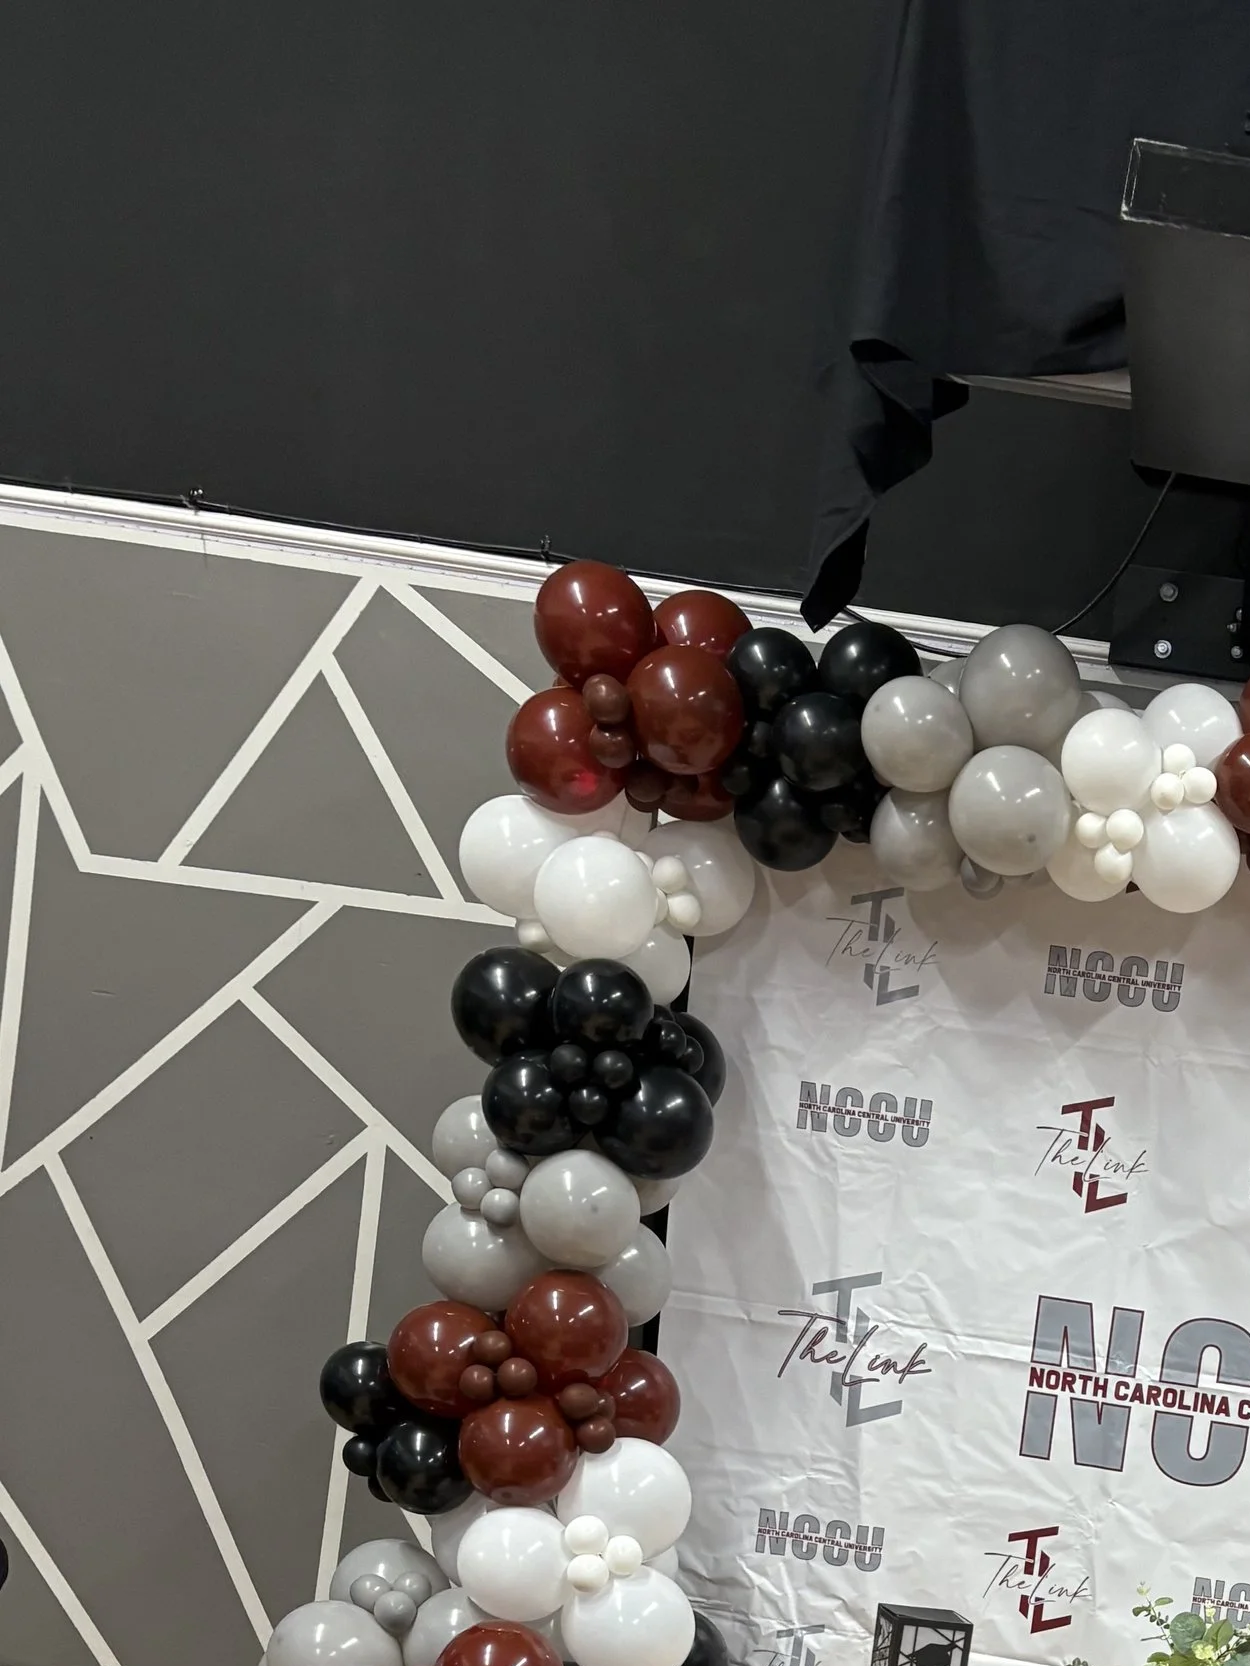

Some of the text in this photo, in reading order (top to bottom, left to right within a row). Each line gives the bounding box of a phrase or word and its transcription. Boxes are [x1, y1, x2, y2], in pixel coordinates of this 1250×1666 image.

[1044, 945, 1184, 1012] NCCU
[1047, 966, 1181, 991] NORTH CAROLINA CENTRAL UNIVERSITY
[796, 1080, 933, 1147] NCCU
[799, 1102, 931, 1128] NORTH CAROLINA CENTRAL UNIVERSITY
[1028, 1367, 1109, 1398] NORTH
[1114, 1381, 1231, 1417] CAROLINA
[755, 1508, 885, 1572] NCCU
[758, 1528, 883, 1552] NORTH CAROLINA CENTRAL UNIVERSITY
[1216, 1600, 1249, 1610] CAROLINA
